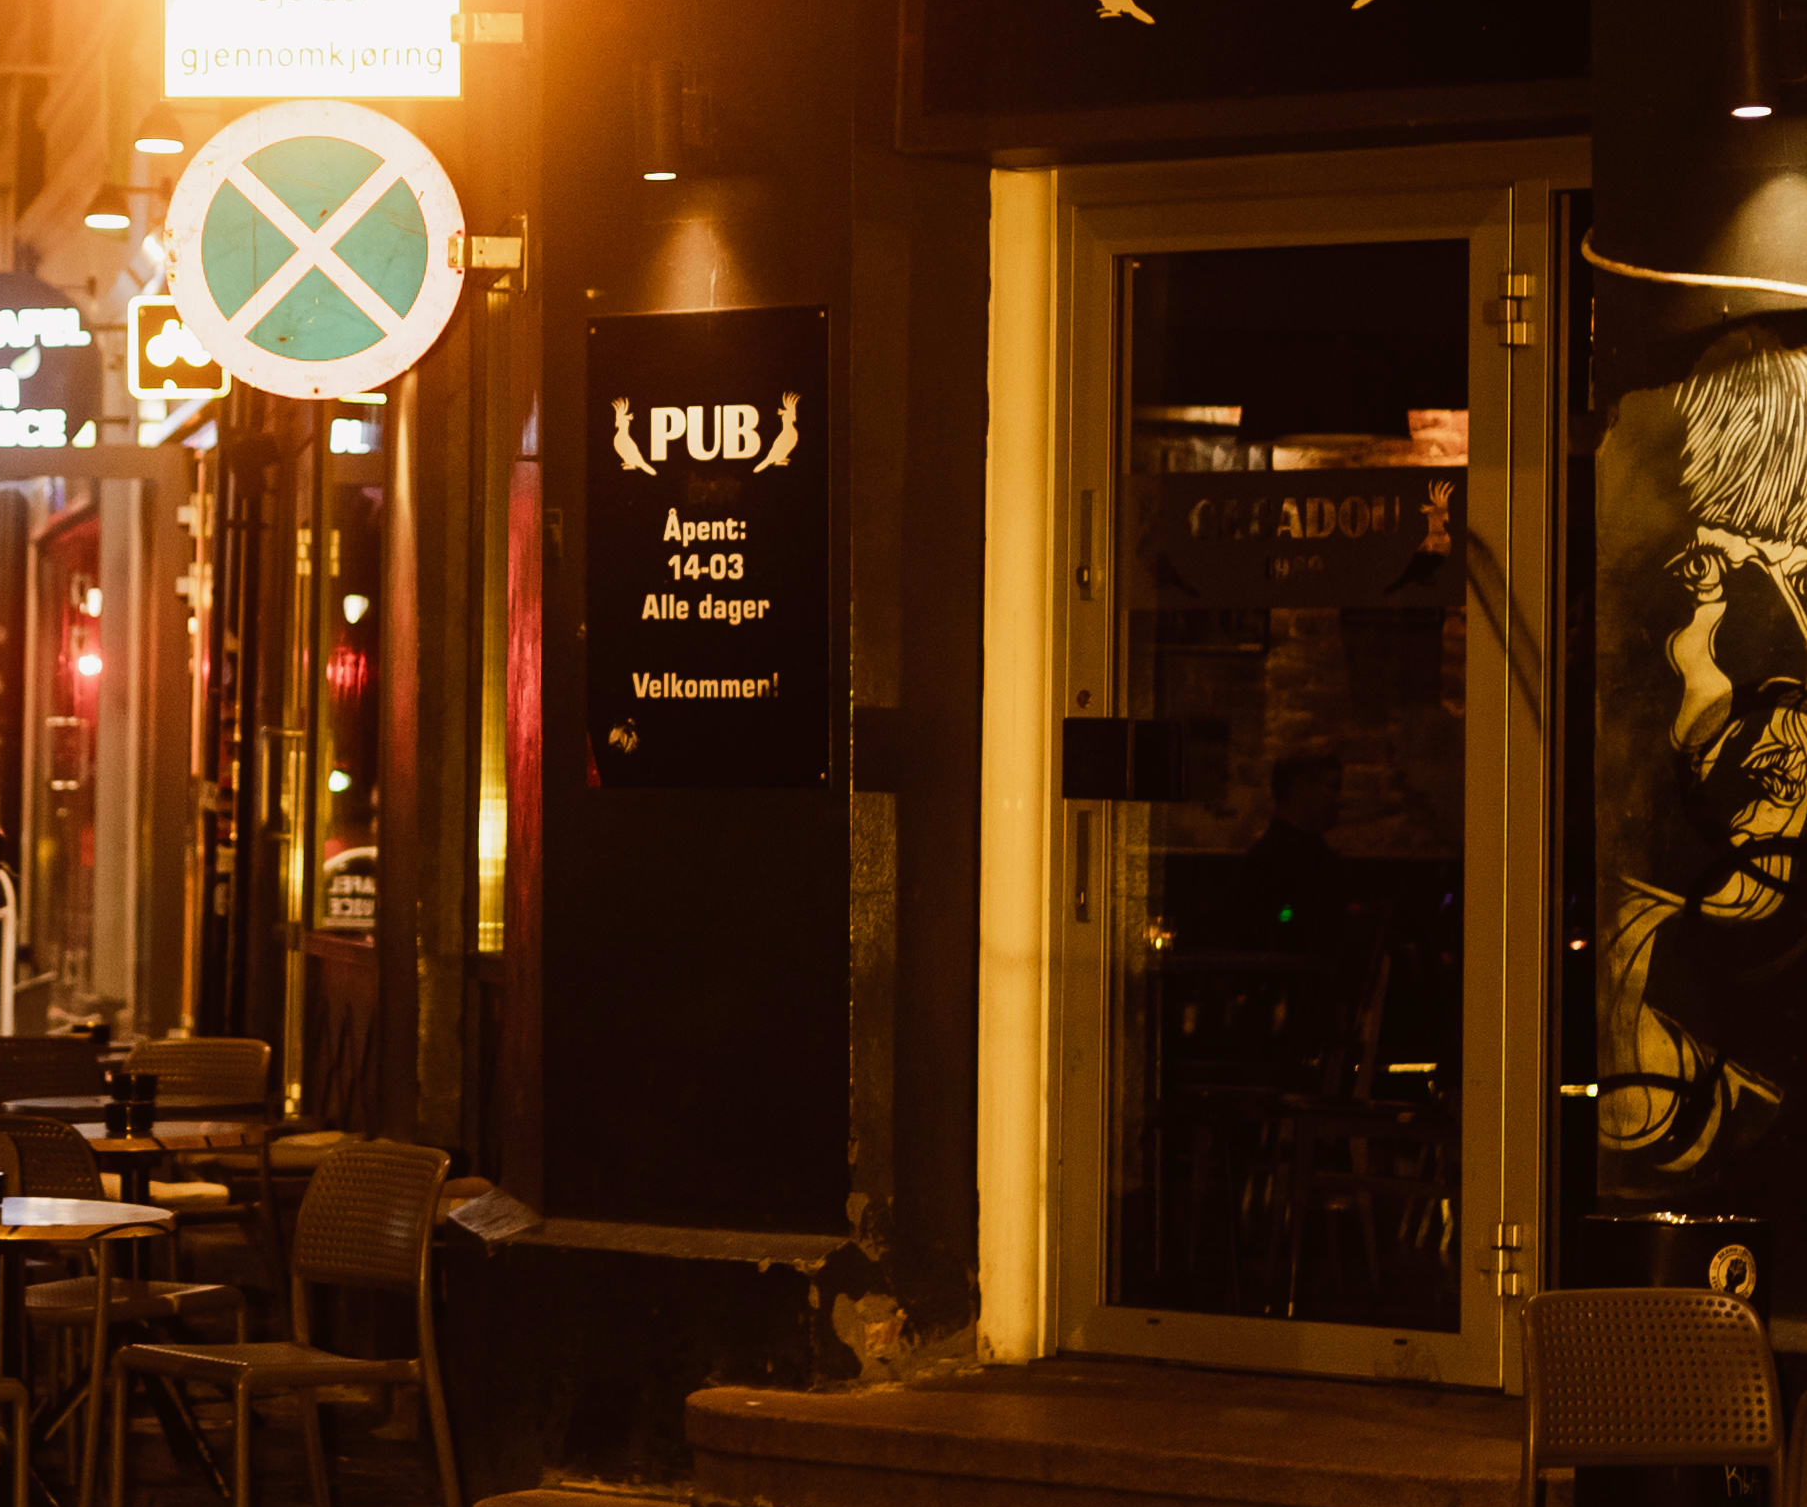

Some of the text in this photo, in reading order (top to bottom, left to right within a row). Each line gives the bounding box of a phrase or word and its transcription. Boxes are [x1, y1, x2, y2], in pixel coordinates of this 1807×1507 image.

[179, 41, 444, 77] gjennomkjøring
[649, 403, 762, 462] PUB
[663, 507, 747, 547] Åpent:
[667, 553, 745, 581] 14-03
[641, 593, 771, 626] Alle dager
[631, 671, 780, 700] Velkommen!
